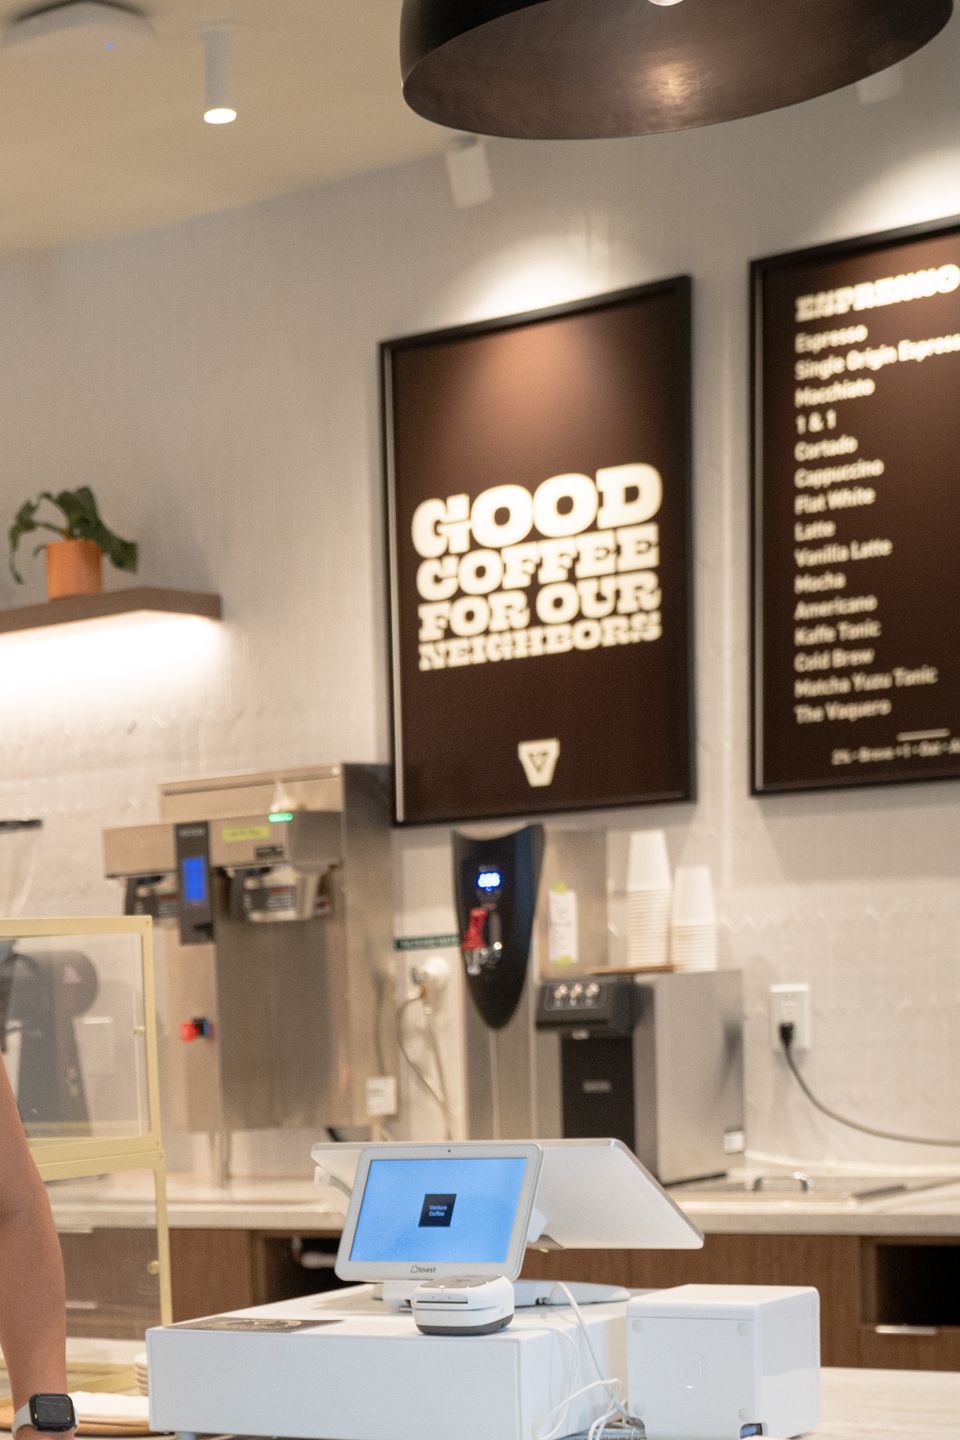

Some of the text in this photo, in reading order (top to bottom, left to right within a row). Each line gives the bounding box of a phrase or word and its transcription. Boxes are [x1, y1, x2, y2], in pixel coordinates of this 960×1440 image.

[794, 324, 868, 354] Espresso
[794, 355, 846, 380] Single
[846, 344, 897, 371] Origin
[794, 378, 876, 407] Macchiato
[794, 434, 858, 461] Cortado
[794, 458, 884, 488] Cappuccino
[411, 463, 662, 558] GOOD
[794, 486, 877, 515] Flat White
[794, 520, 836, 541] Latte
[416, 523, 660, 601] COFFEE
[794, 538, 893, 567] Vanilla Latte
[794, 571, 847, 594] Mocha
[418, 570, 662, 643] FOR OUR
[794, 595, 878, 620] Americano
[418, 610, 663, 671] NEIGHBORS
[837, 619, 882, 641] Tonic
[794, 648, 875, 672] Cold Brew
[794, 665, 938, 698] Matcha Yuzu Tonic
[794, 705, 825, 724] The
